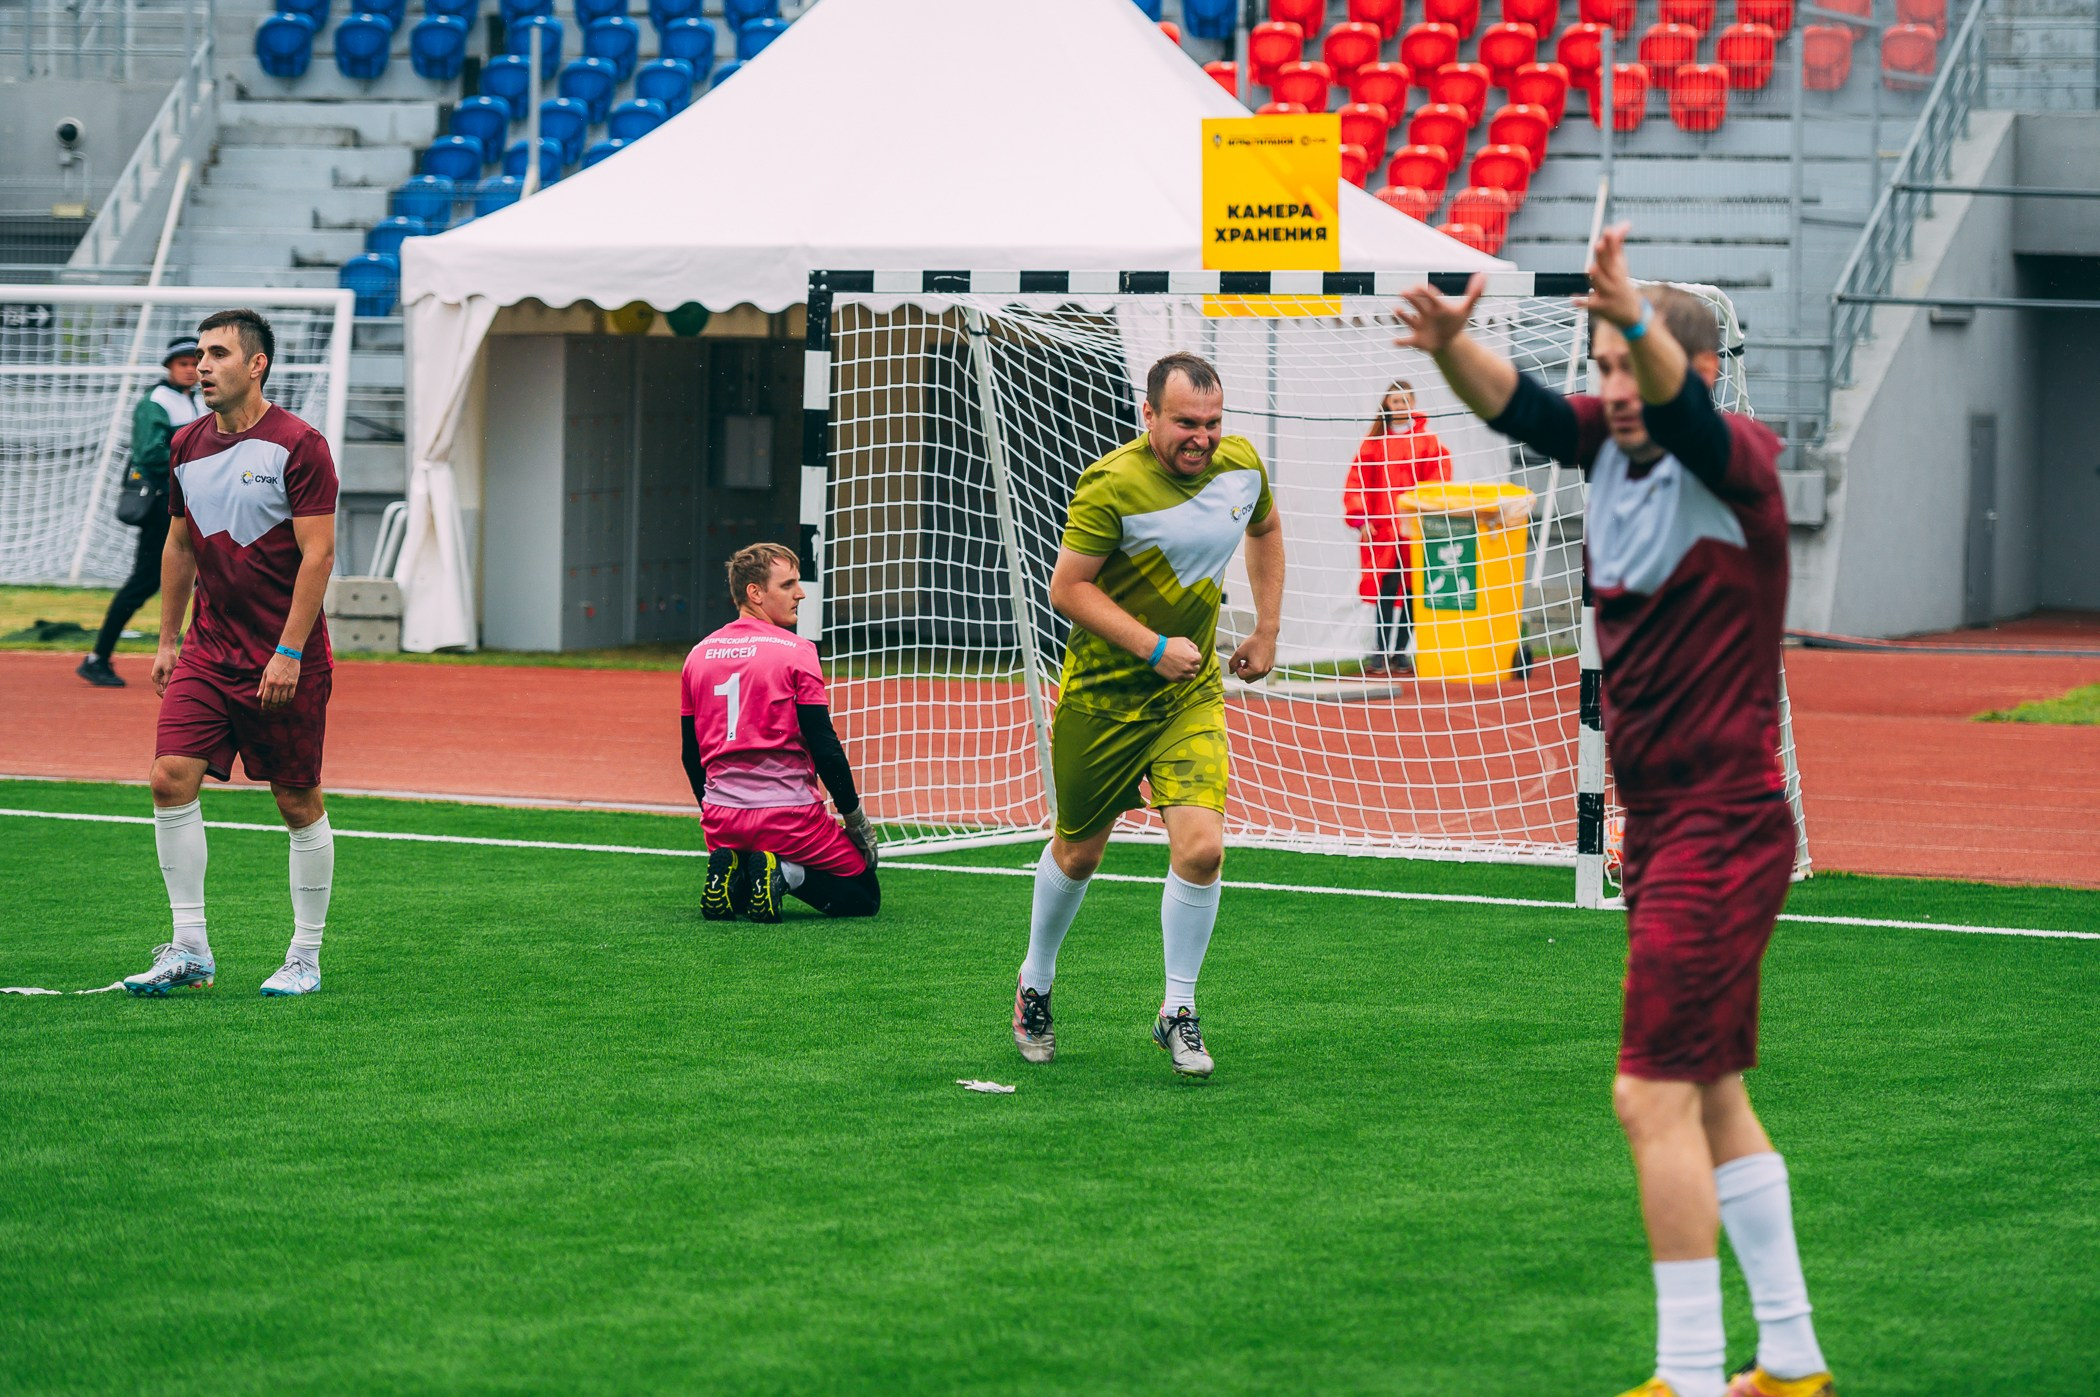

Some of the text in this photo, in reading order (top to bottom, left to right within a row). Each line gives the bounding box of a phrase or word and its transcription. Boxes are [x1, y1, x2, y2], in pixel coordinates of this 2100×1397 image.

[1227, 203, 1314, 219] КАМЕРА
[1214, 227, 1327, 242] ХРАНЕНИЯ
[255, 475, 278, 484] СУЭК
[749, 636, 797, 648] ДИВИЗИОН
[705, 645, 757, 659] ЕНИСЕЙ
[713, 672, 740, 741] 1
